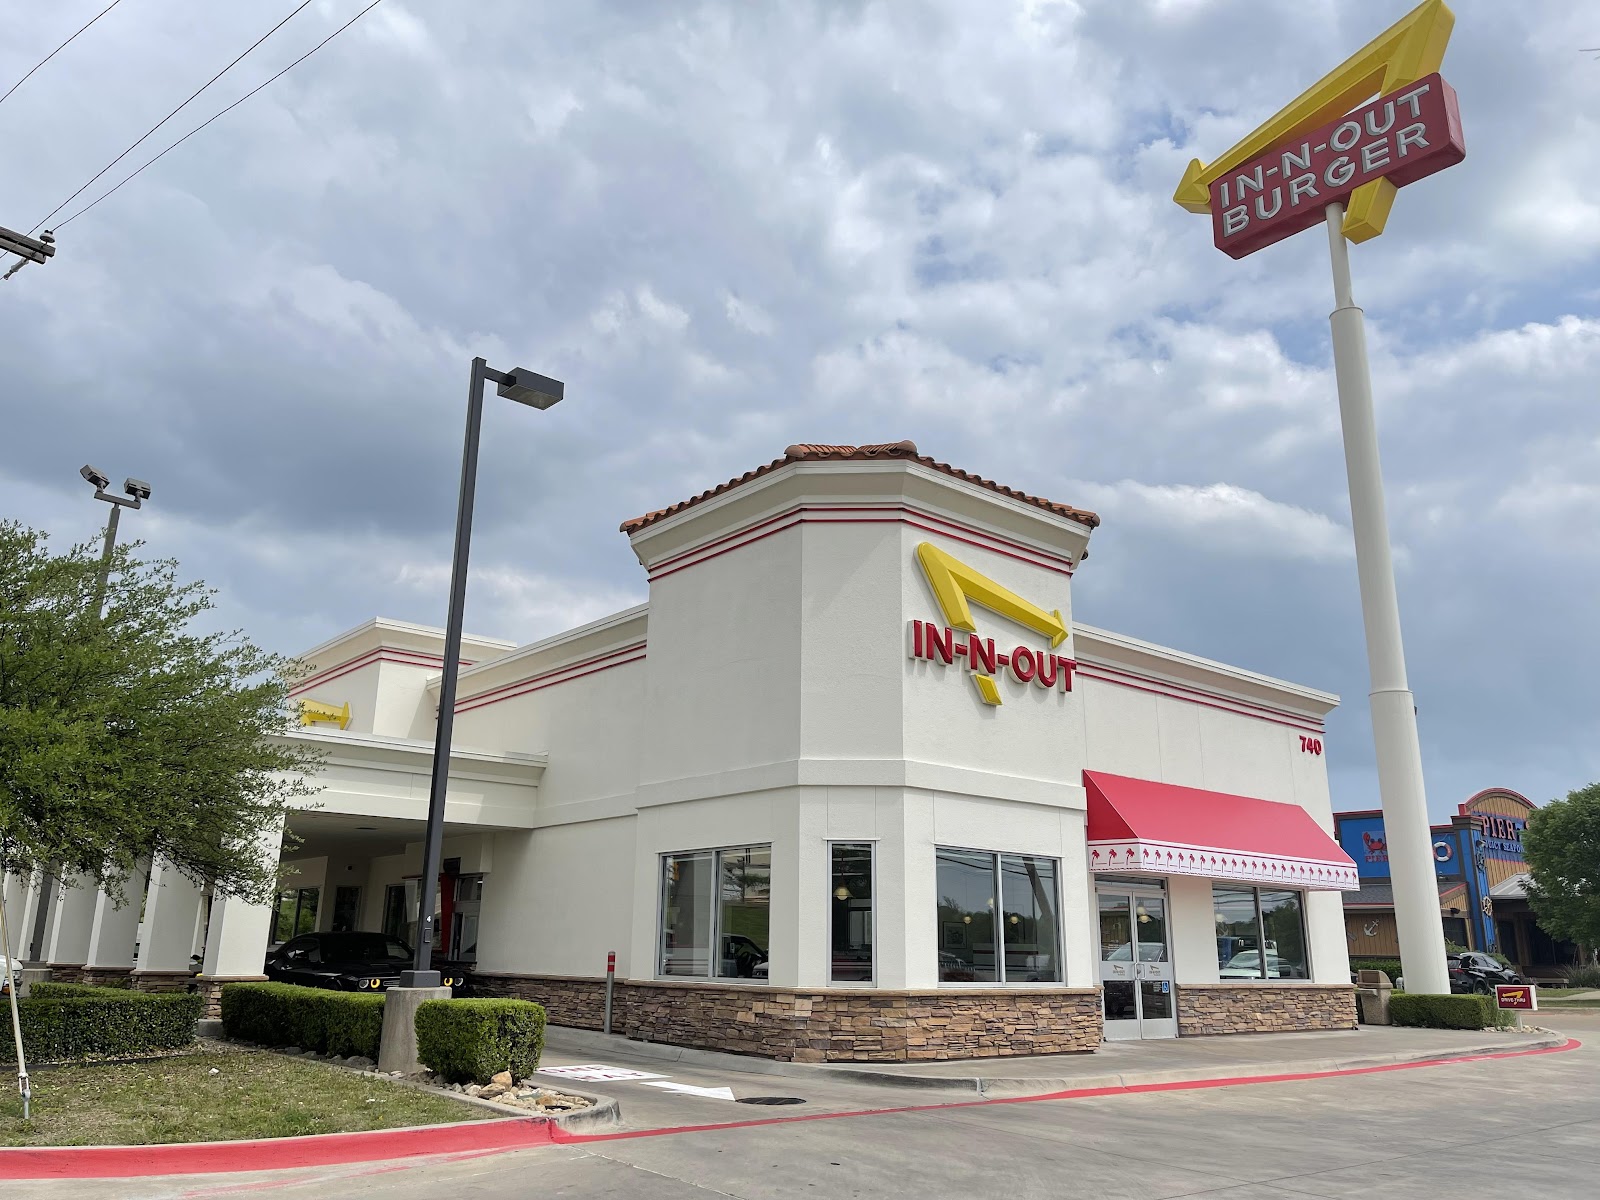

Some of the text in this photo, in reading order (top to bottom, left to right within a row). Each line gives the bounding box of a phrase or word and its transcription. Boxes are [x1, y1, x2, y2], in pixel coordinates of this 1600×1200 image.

[1220, 84, 1430, 208] IN-N-OUT
[1222, 122, 1430, 237] BURGER
[909, 620, 1077, 693] IN-N-OUT
[1299, 735, 1322, 756] 740
[1481, 815, 1517, 841] PIER
